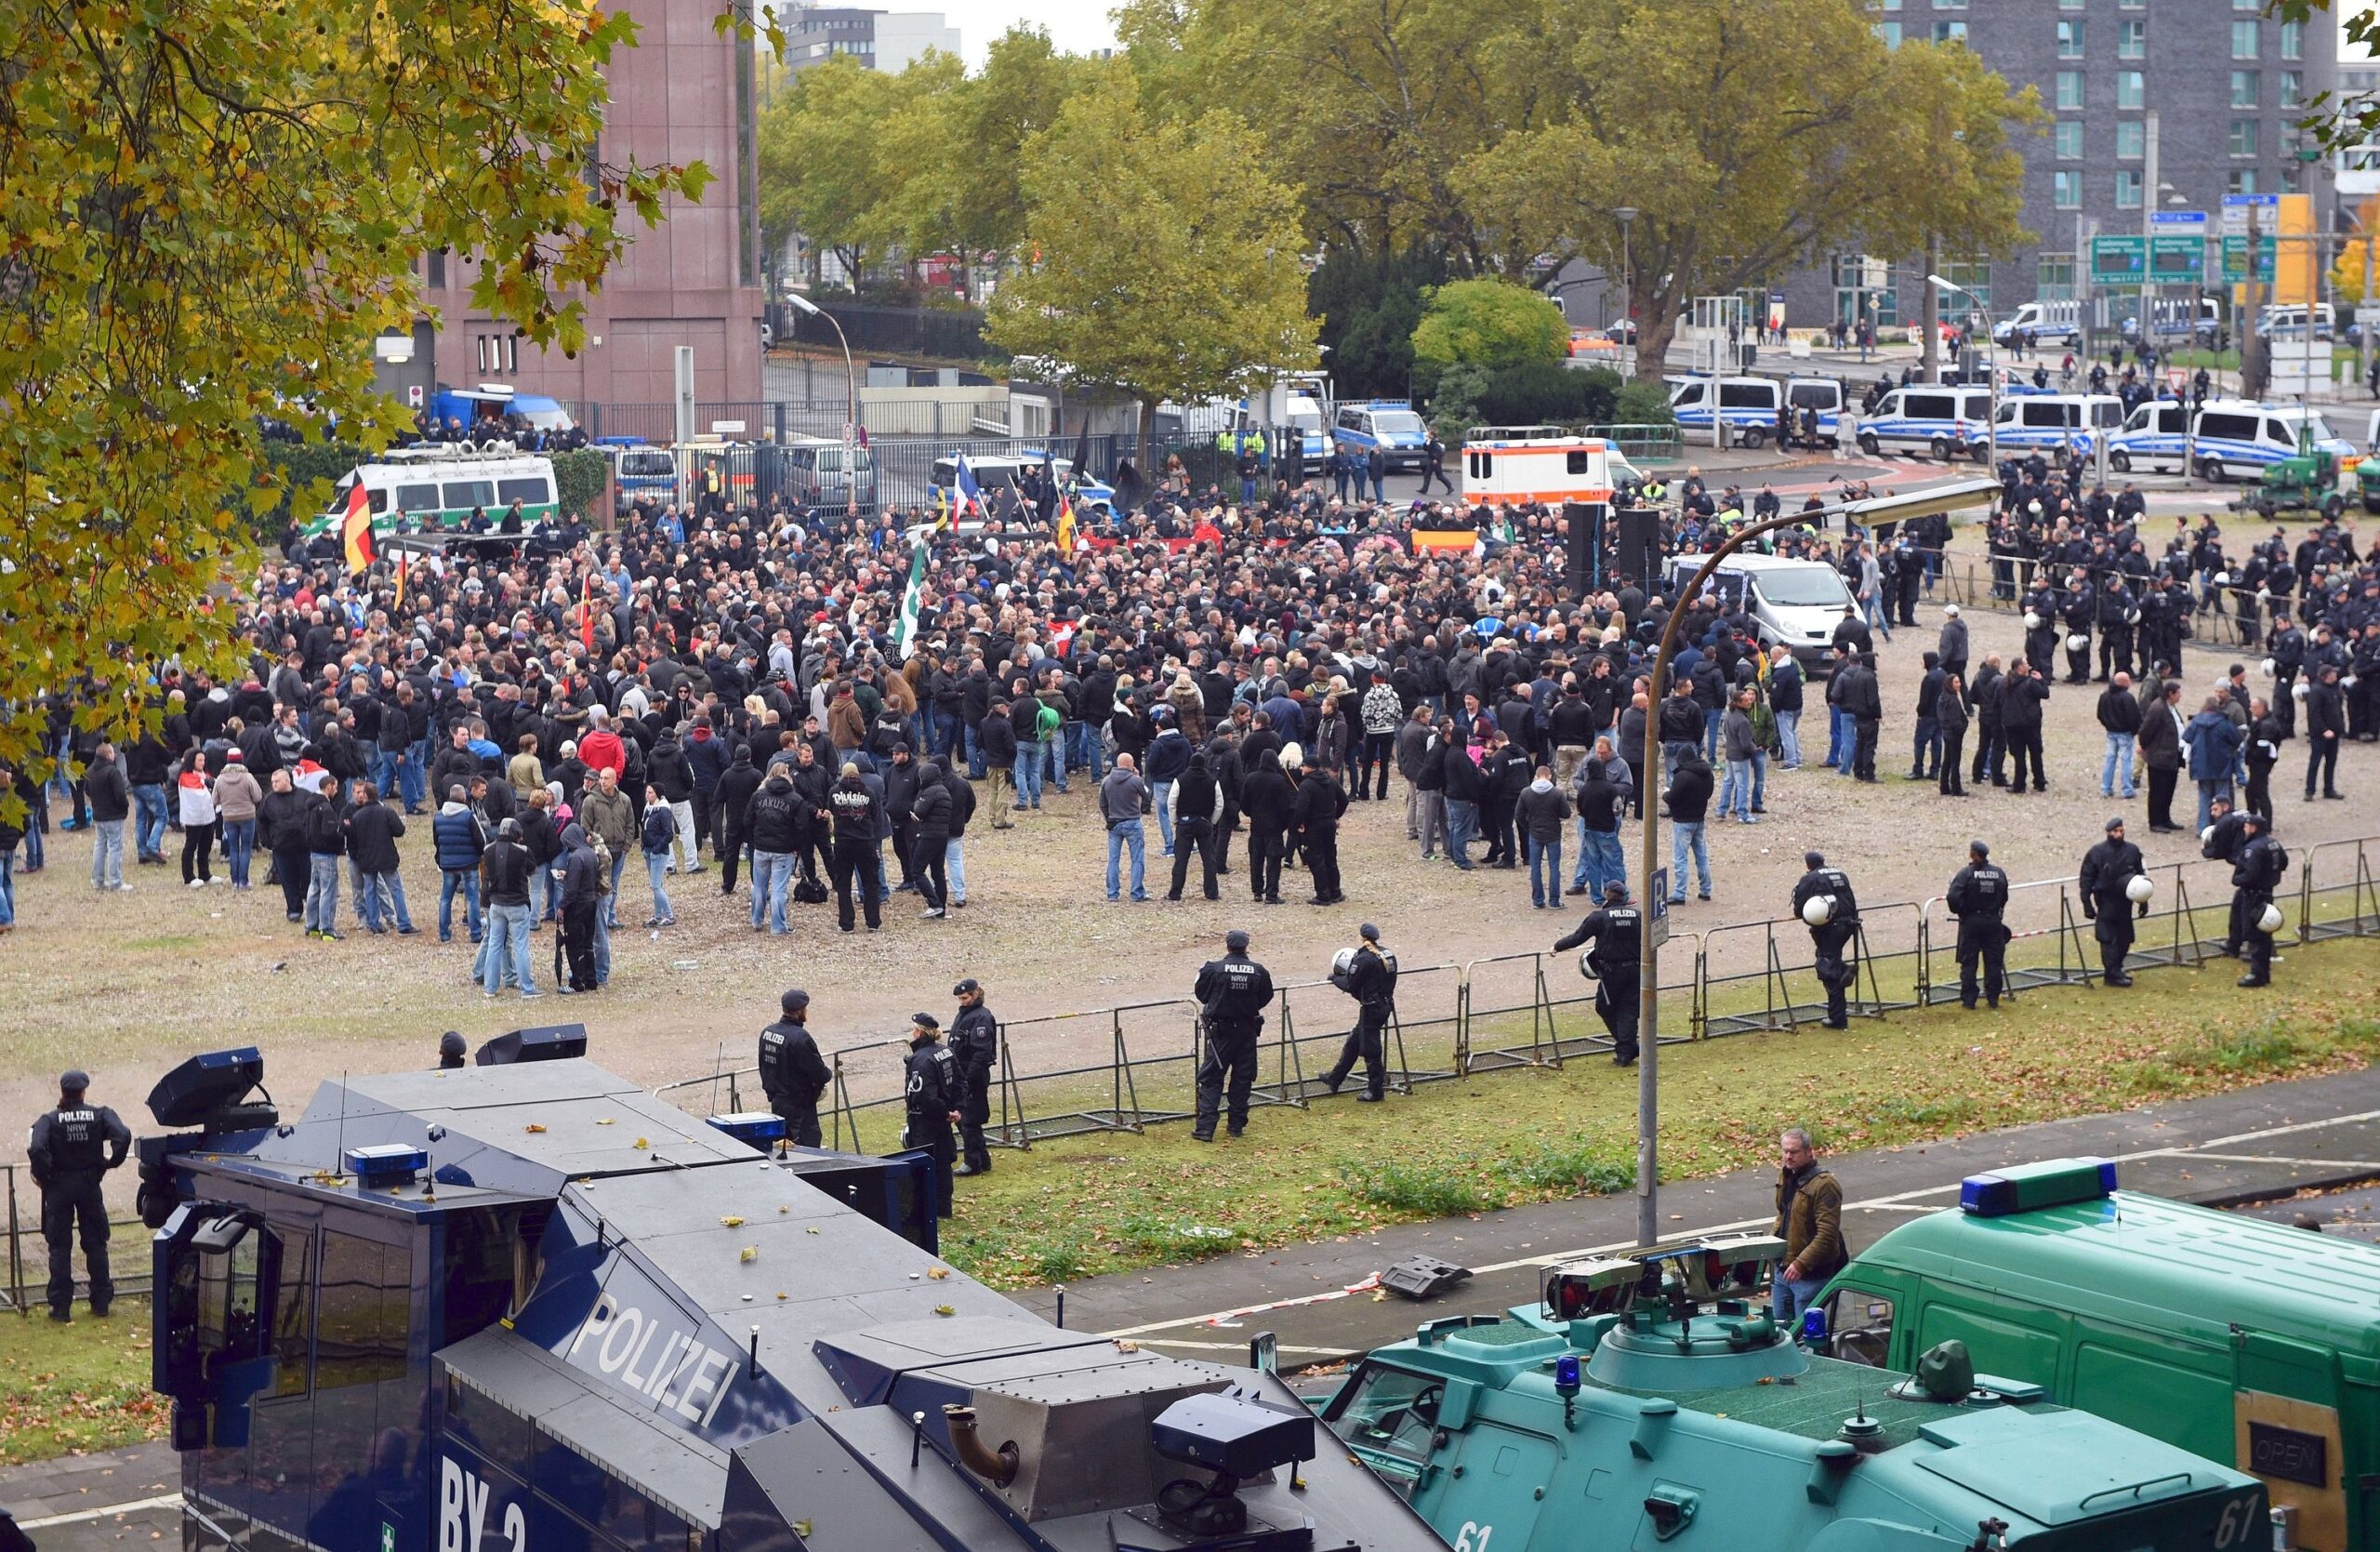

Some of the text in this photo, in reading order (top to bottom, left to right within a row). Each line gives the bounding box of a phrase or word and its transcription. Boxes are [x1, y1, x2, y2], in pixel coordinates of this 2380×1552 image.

[758, 798, 790, 812] YAKUZA
[1974, 870, 1999, 879] POLIZEI
[1655, 877, 1663, 919] P
[1224, 964, 1254, 974] POLIZEI
[762, 1030, 785, 1044] POLIZEI
[933, 1048, 953, 1061] POLIZEI
[59, 1110, 95, 1123] POLIZEI
[67, 1123, 86, 1133] NRW
[571, 1292, 740, 1428] POLIZEI
[2255, 1439, 2315, 1467] OPEN
[440, 1454, 490, 1552] BY
[2215, 1493, 2260, 1549] 61
[1455, 1520, 1492, 1552] 61
